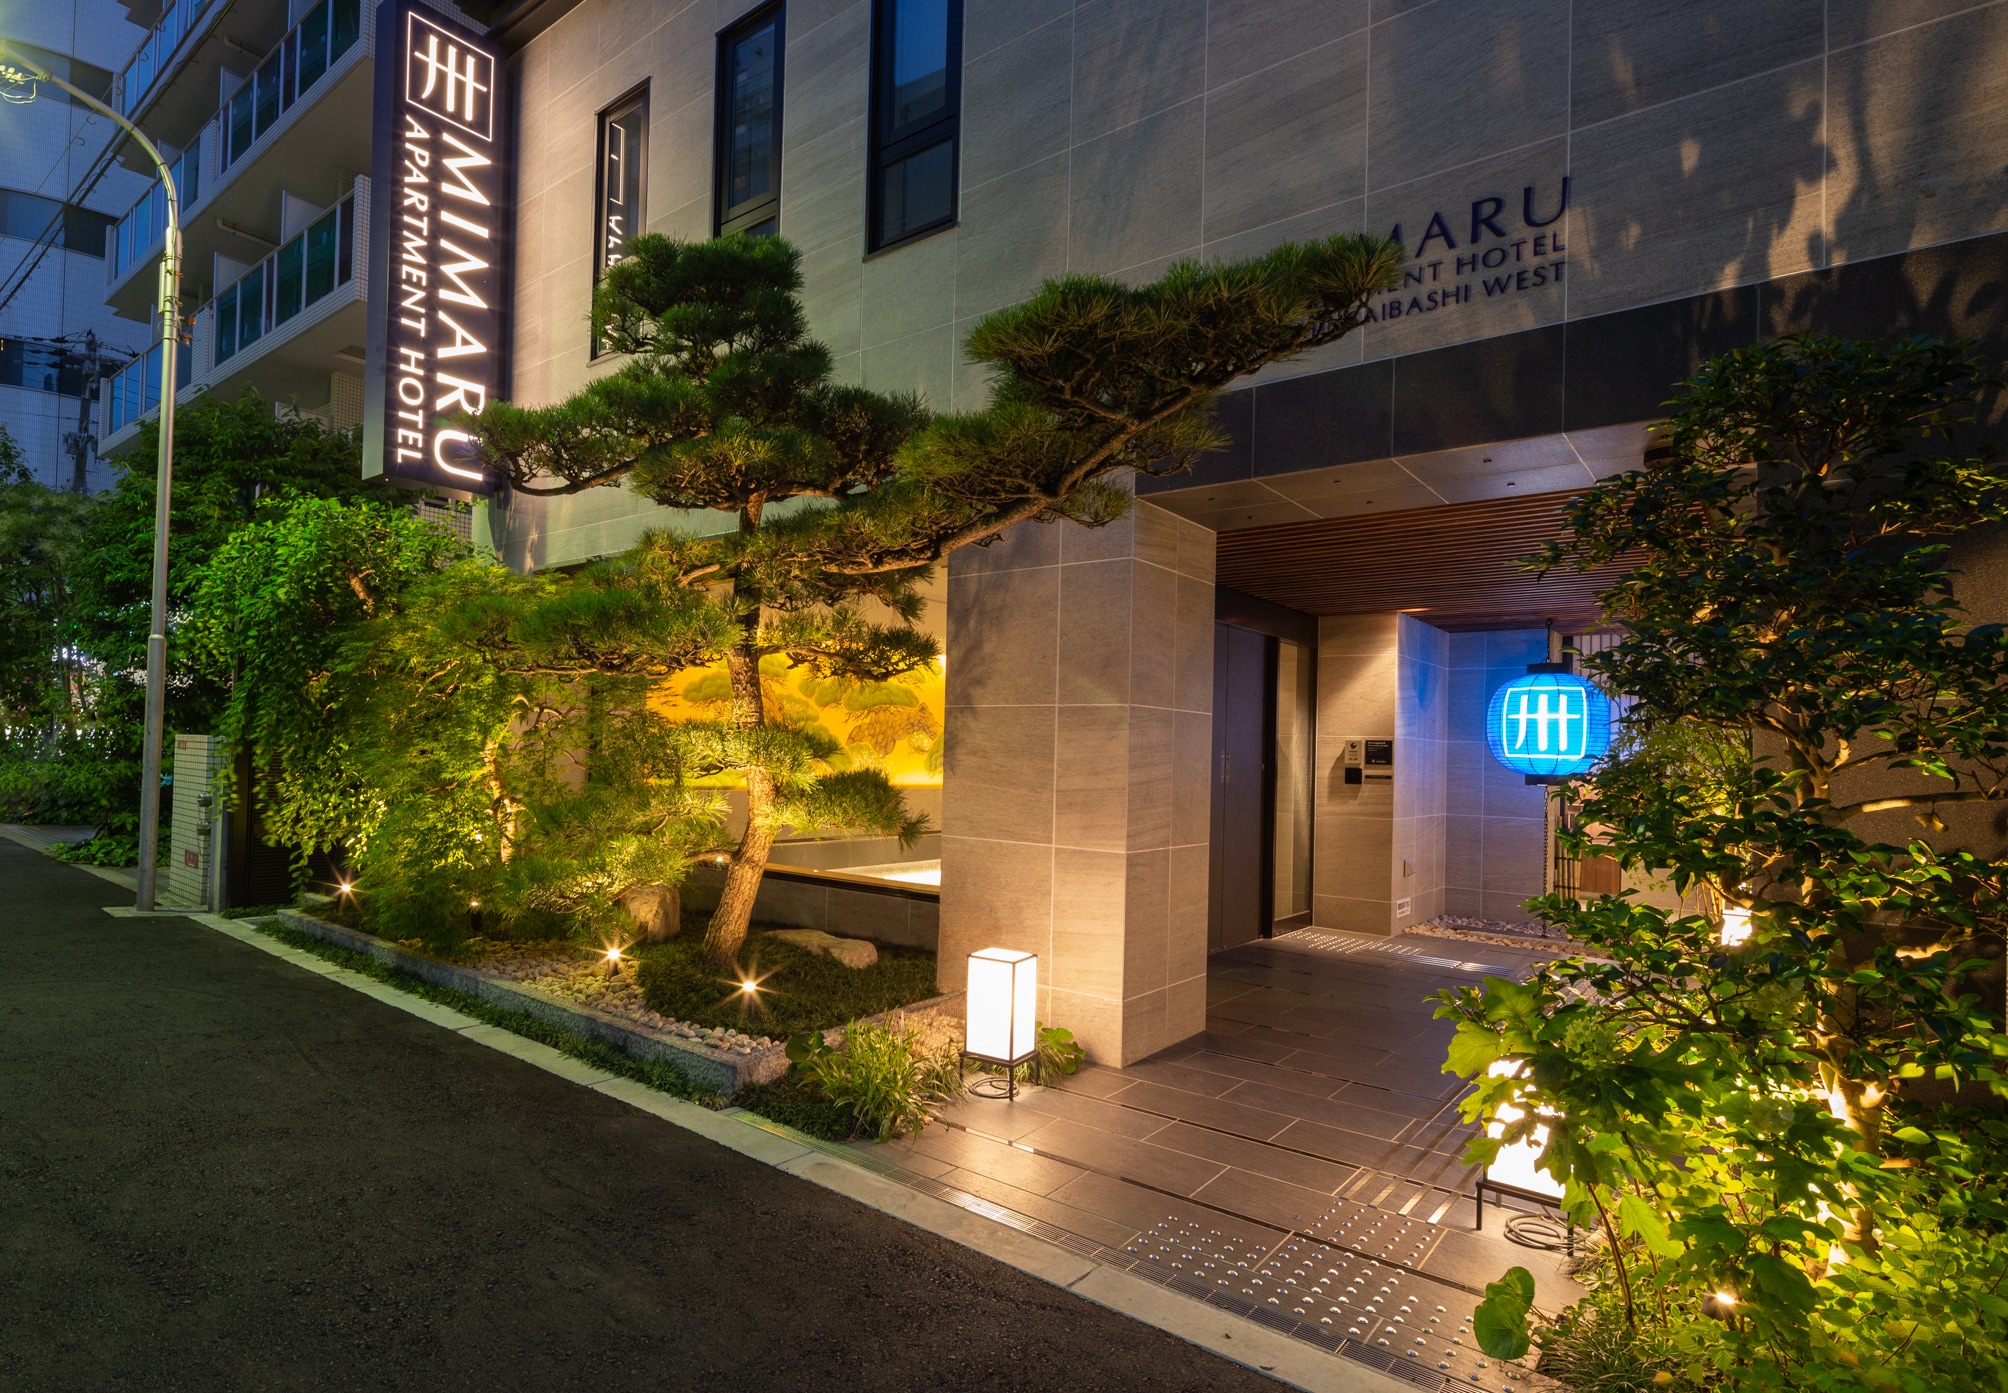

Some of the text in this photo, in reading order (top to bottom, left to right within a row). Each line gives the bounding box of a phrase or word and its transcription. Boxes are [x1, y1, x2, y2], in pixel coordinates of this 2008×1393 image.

[397, 115, 430, 463] APARTMENT HOTEL
[434, 132, 491, 481] MIMARU
[1456, 231, 1566, 275] HOTEL
[1482, 261, 1566, 297] WEST
